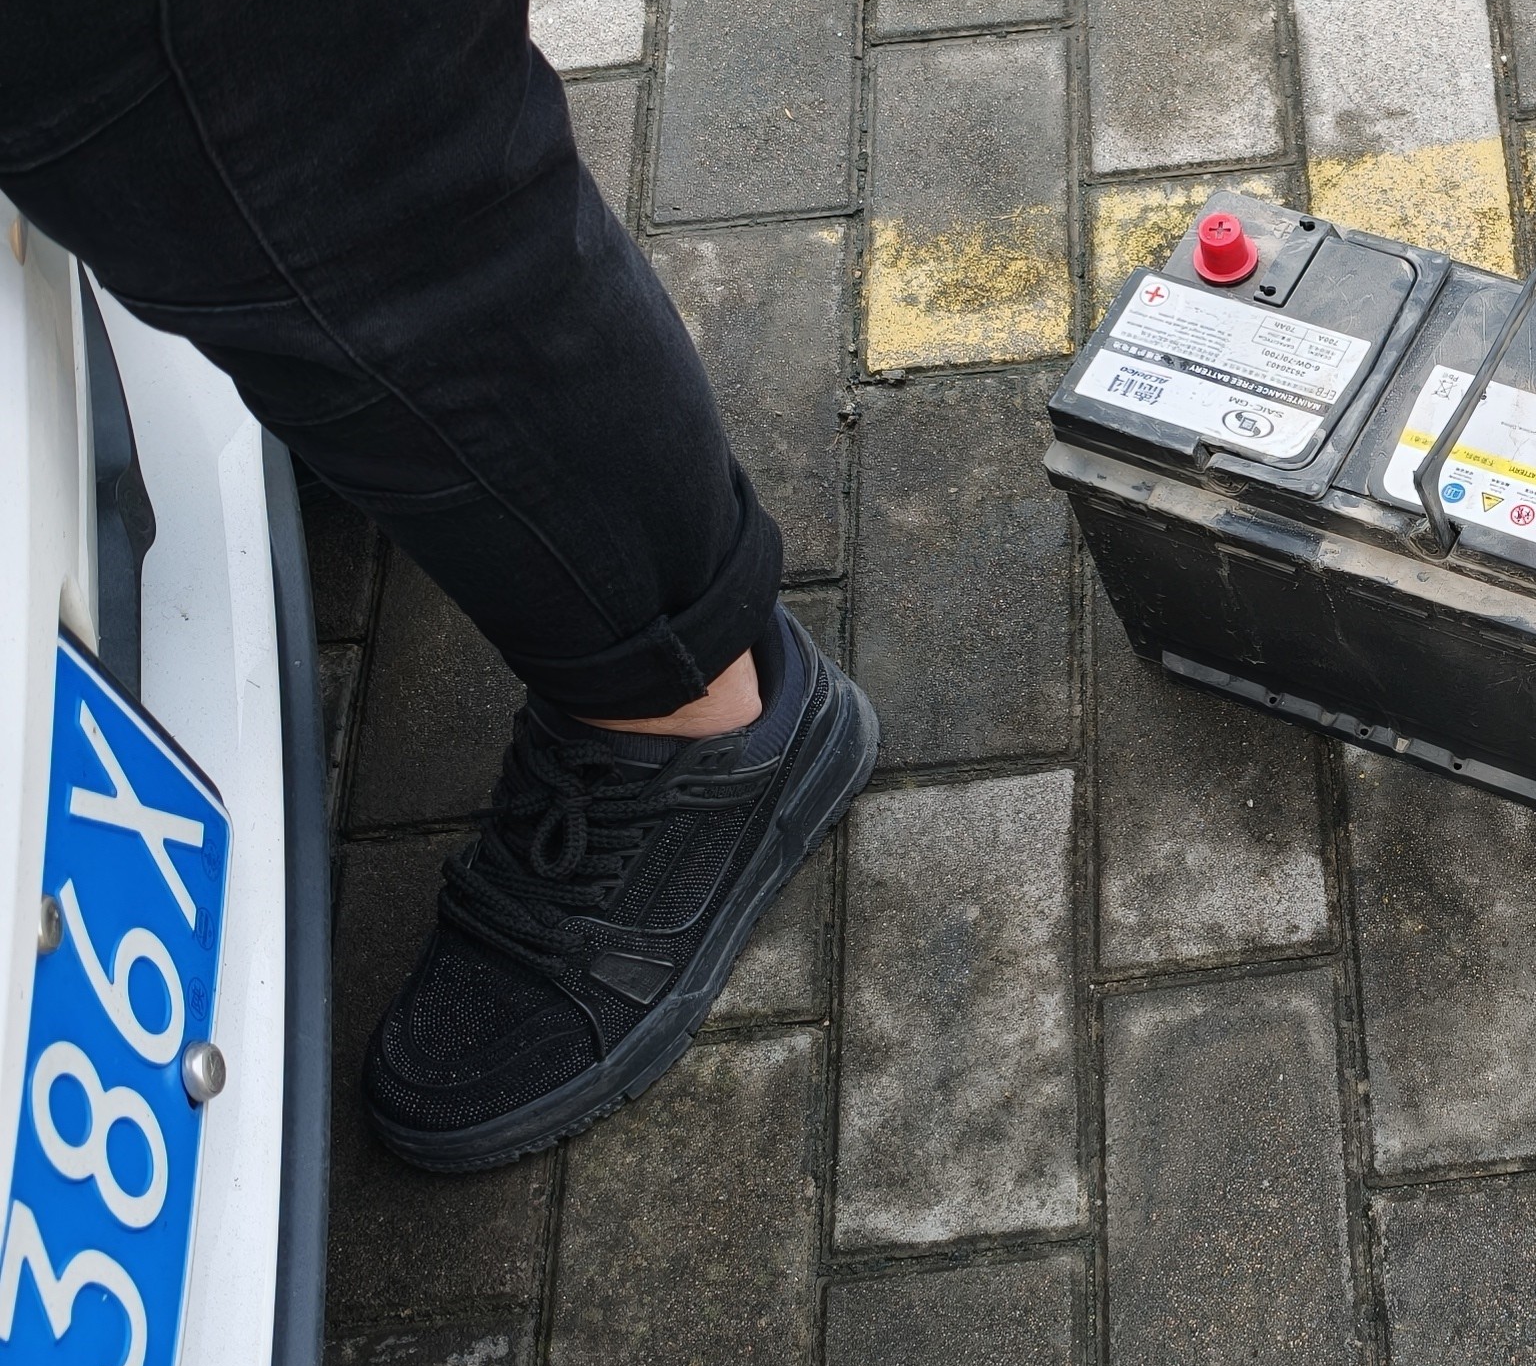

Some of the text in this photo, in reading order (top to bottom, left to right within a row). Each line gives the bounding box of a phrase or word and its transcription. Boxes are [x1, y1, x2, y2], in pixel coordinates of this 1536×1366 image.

[1117, 365, 1170, 386] ACDelco
[1187, 363, 1231, 382] BATTERY
[1105, 373, 1165, 406] 德科
[1227, 376, 1323, 410] MAINTENANCE-FREE
[1226, 395, 1285, 418] SAIC-GM
